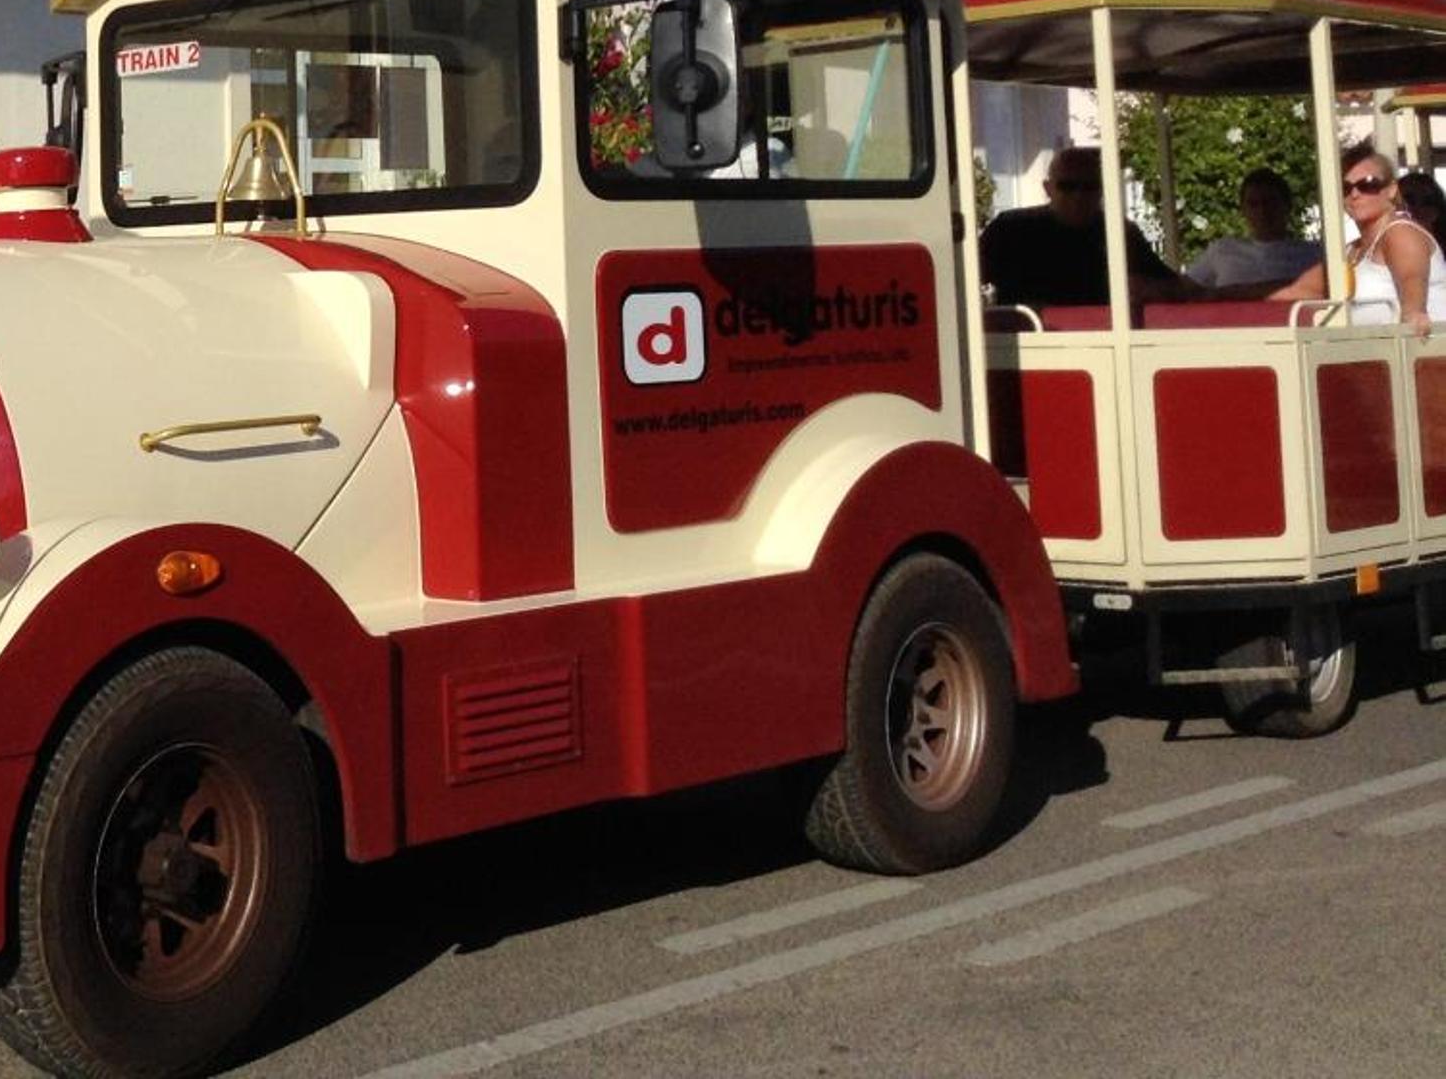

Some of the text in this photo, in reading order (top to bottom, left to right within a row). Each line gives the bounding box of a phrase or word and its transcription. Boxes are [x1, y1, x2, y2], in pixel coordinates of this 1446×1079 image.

[116, 43, 200, 73] TRAIN 2
[715, 278, 919, 345] delgaturis
[614, 401, 805, 435] www.delgaturis.com
